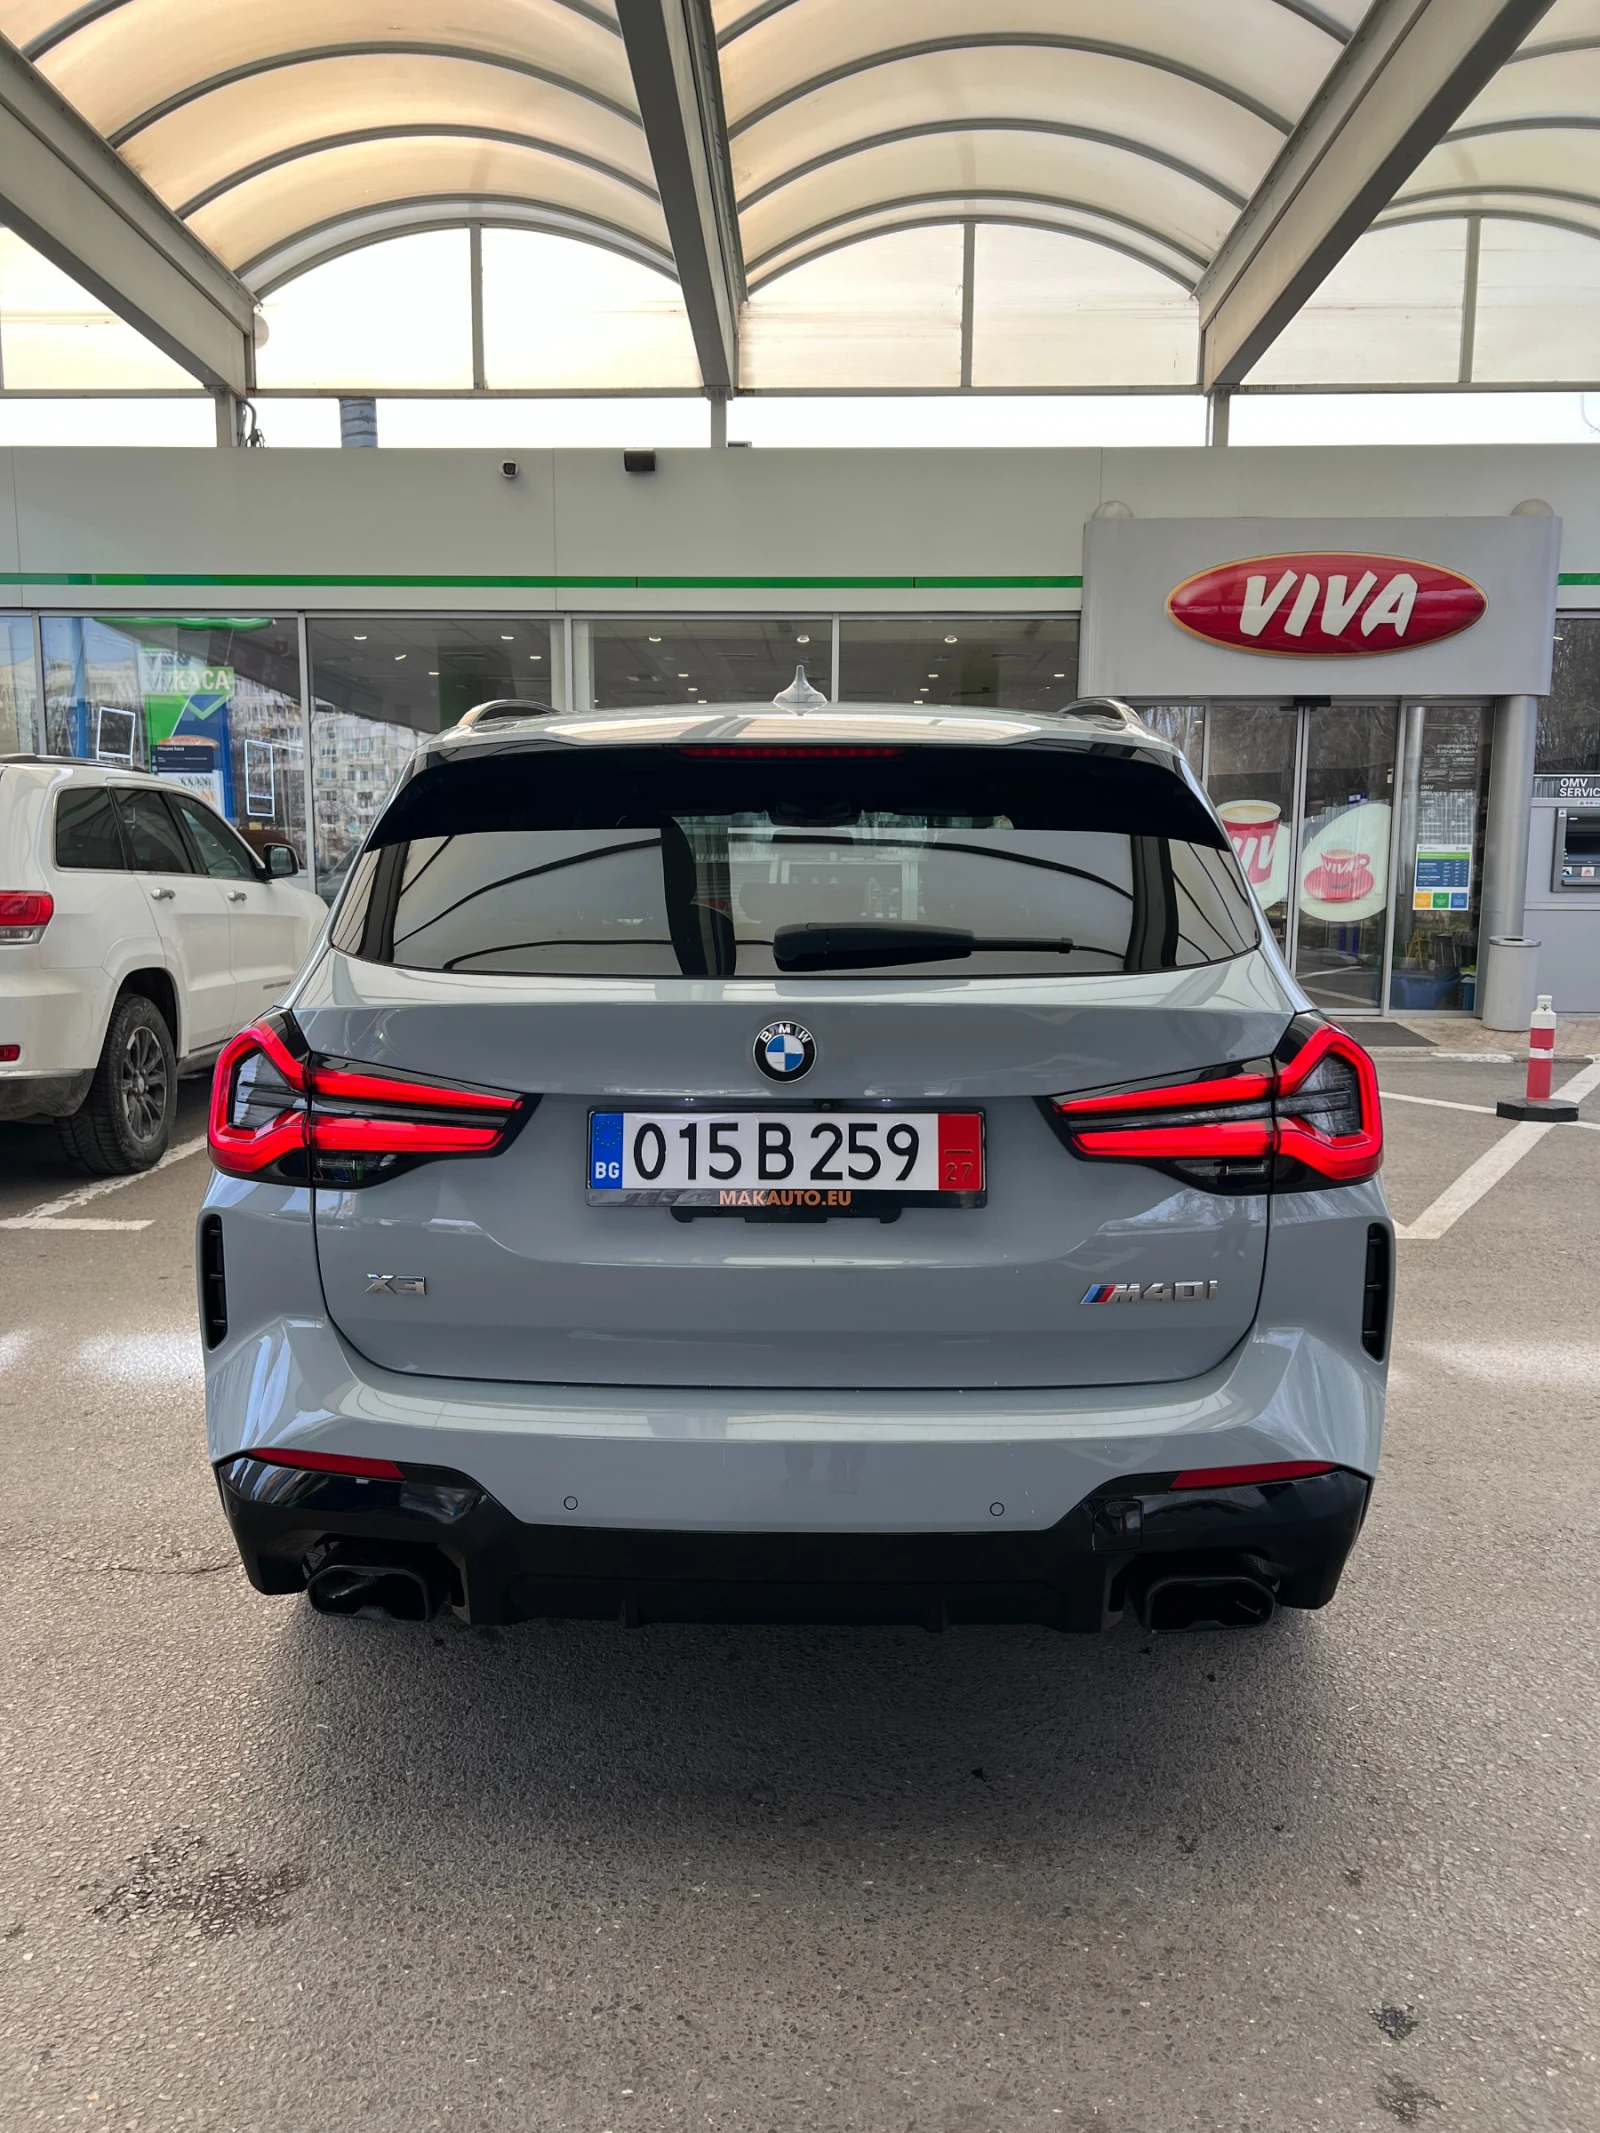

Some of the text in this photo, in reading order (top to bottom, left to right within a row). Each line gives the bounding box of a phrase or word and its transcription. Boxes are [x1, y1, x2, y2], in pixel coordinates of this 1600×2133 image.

[1239, 569, 1418, 637] VIVA
[1560, 778, 1588, 787] OMV
[760, 1023, 812, 1043] BMW
[595, 1162, 620, 1179] BG
[945, 1162, 973, 1183] 27
[719, 1190, 852, 1206] MAKAUTO.EU
[365, 1273, 426, 1295] X3
[1106, 1280, 1218, 1303] M40i
